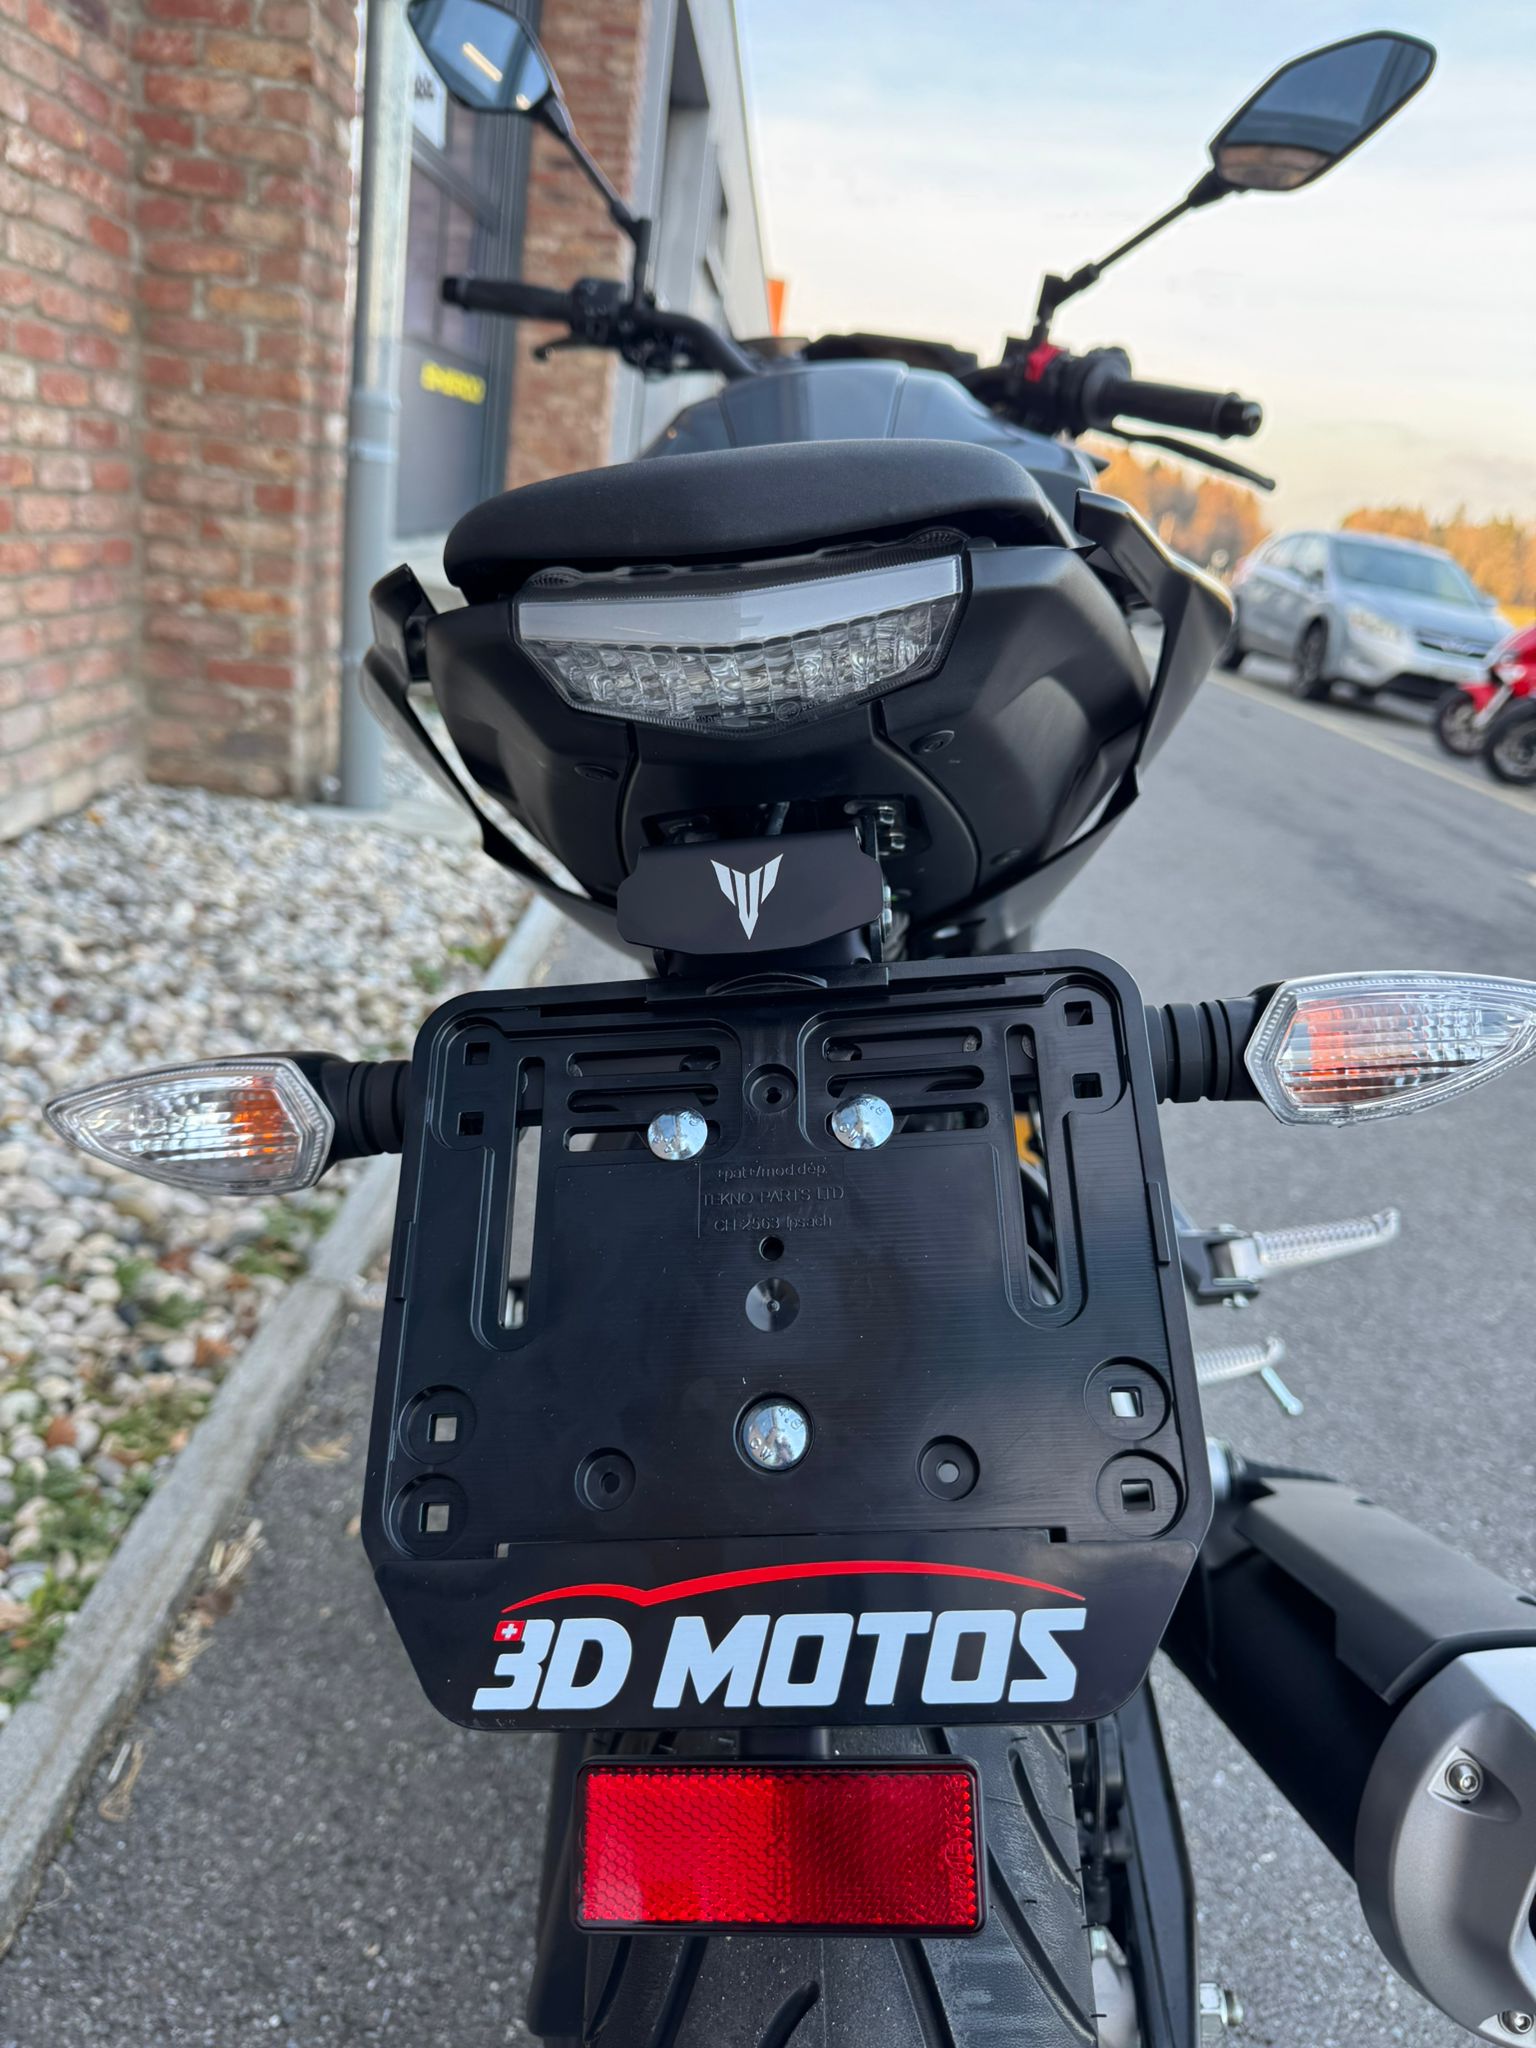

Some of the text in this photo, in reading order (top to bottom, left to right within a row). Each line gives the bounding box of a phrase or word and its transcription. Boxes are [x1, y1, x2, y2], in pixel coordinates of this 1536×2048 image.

[702, 1186, 845, 1206] TEKNO PARTS LTD
[786, 1213, 833, 1231] Ipsach
[472, 1607, 1087, 1711] 3D MOTOS
